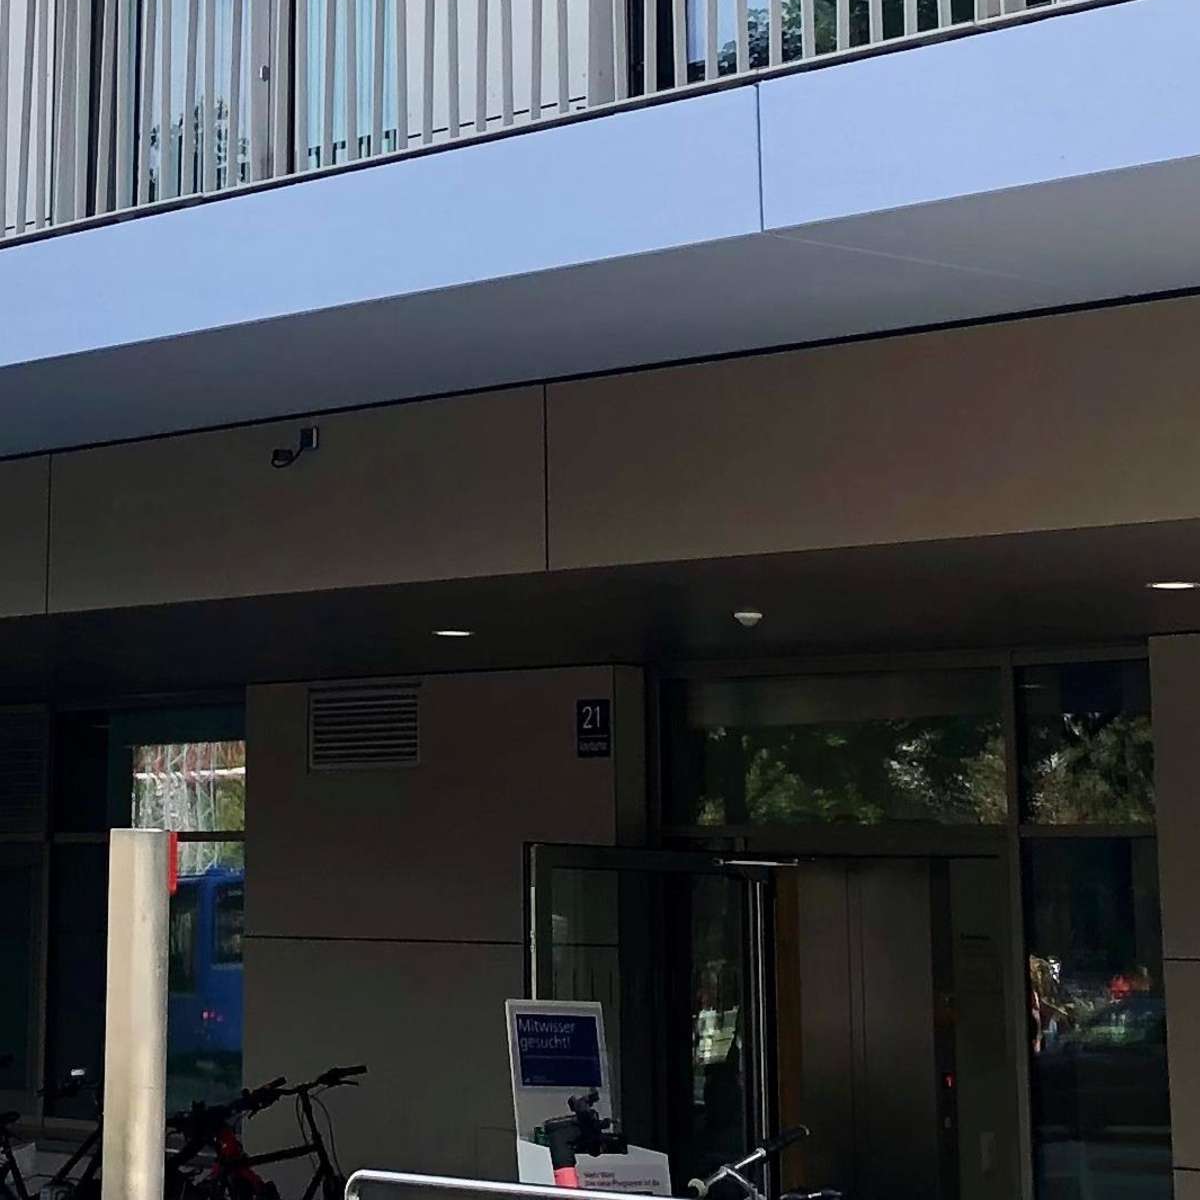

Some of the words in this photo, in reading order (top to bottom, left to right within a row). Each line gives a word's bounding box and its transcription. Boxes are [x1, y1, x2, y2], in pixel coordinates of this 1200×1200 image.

[582, 705, 601, 729] 21
[518, 1018, 576, 1034] Mitwisser
[520, 1035, 571, 1052] gesucht!
